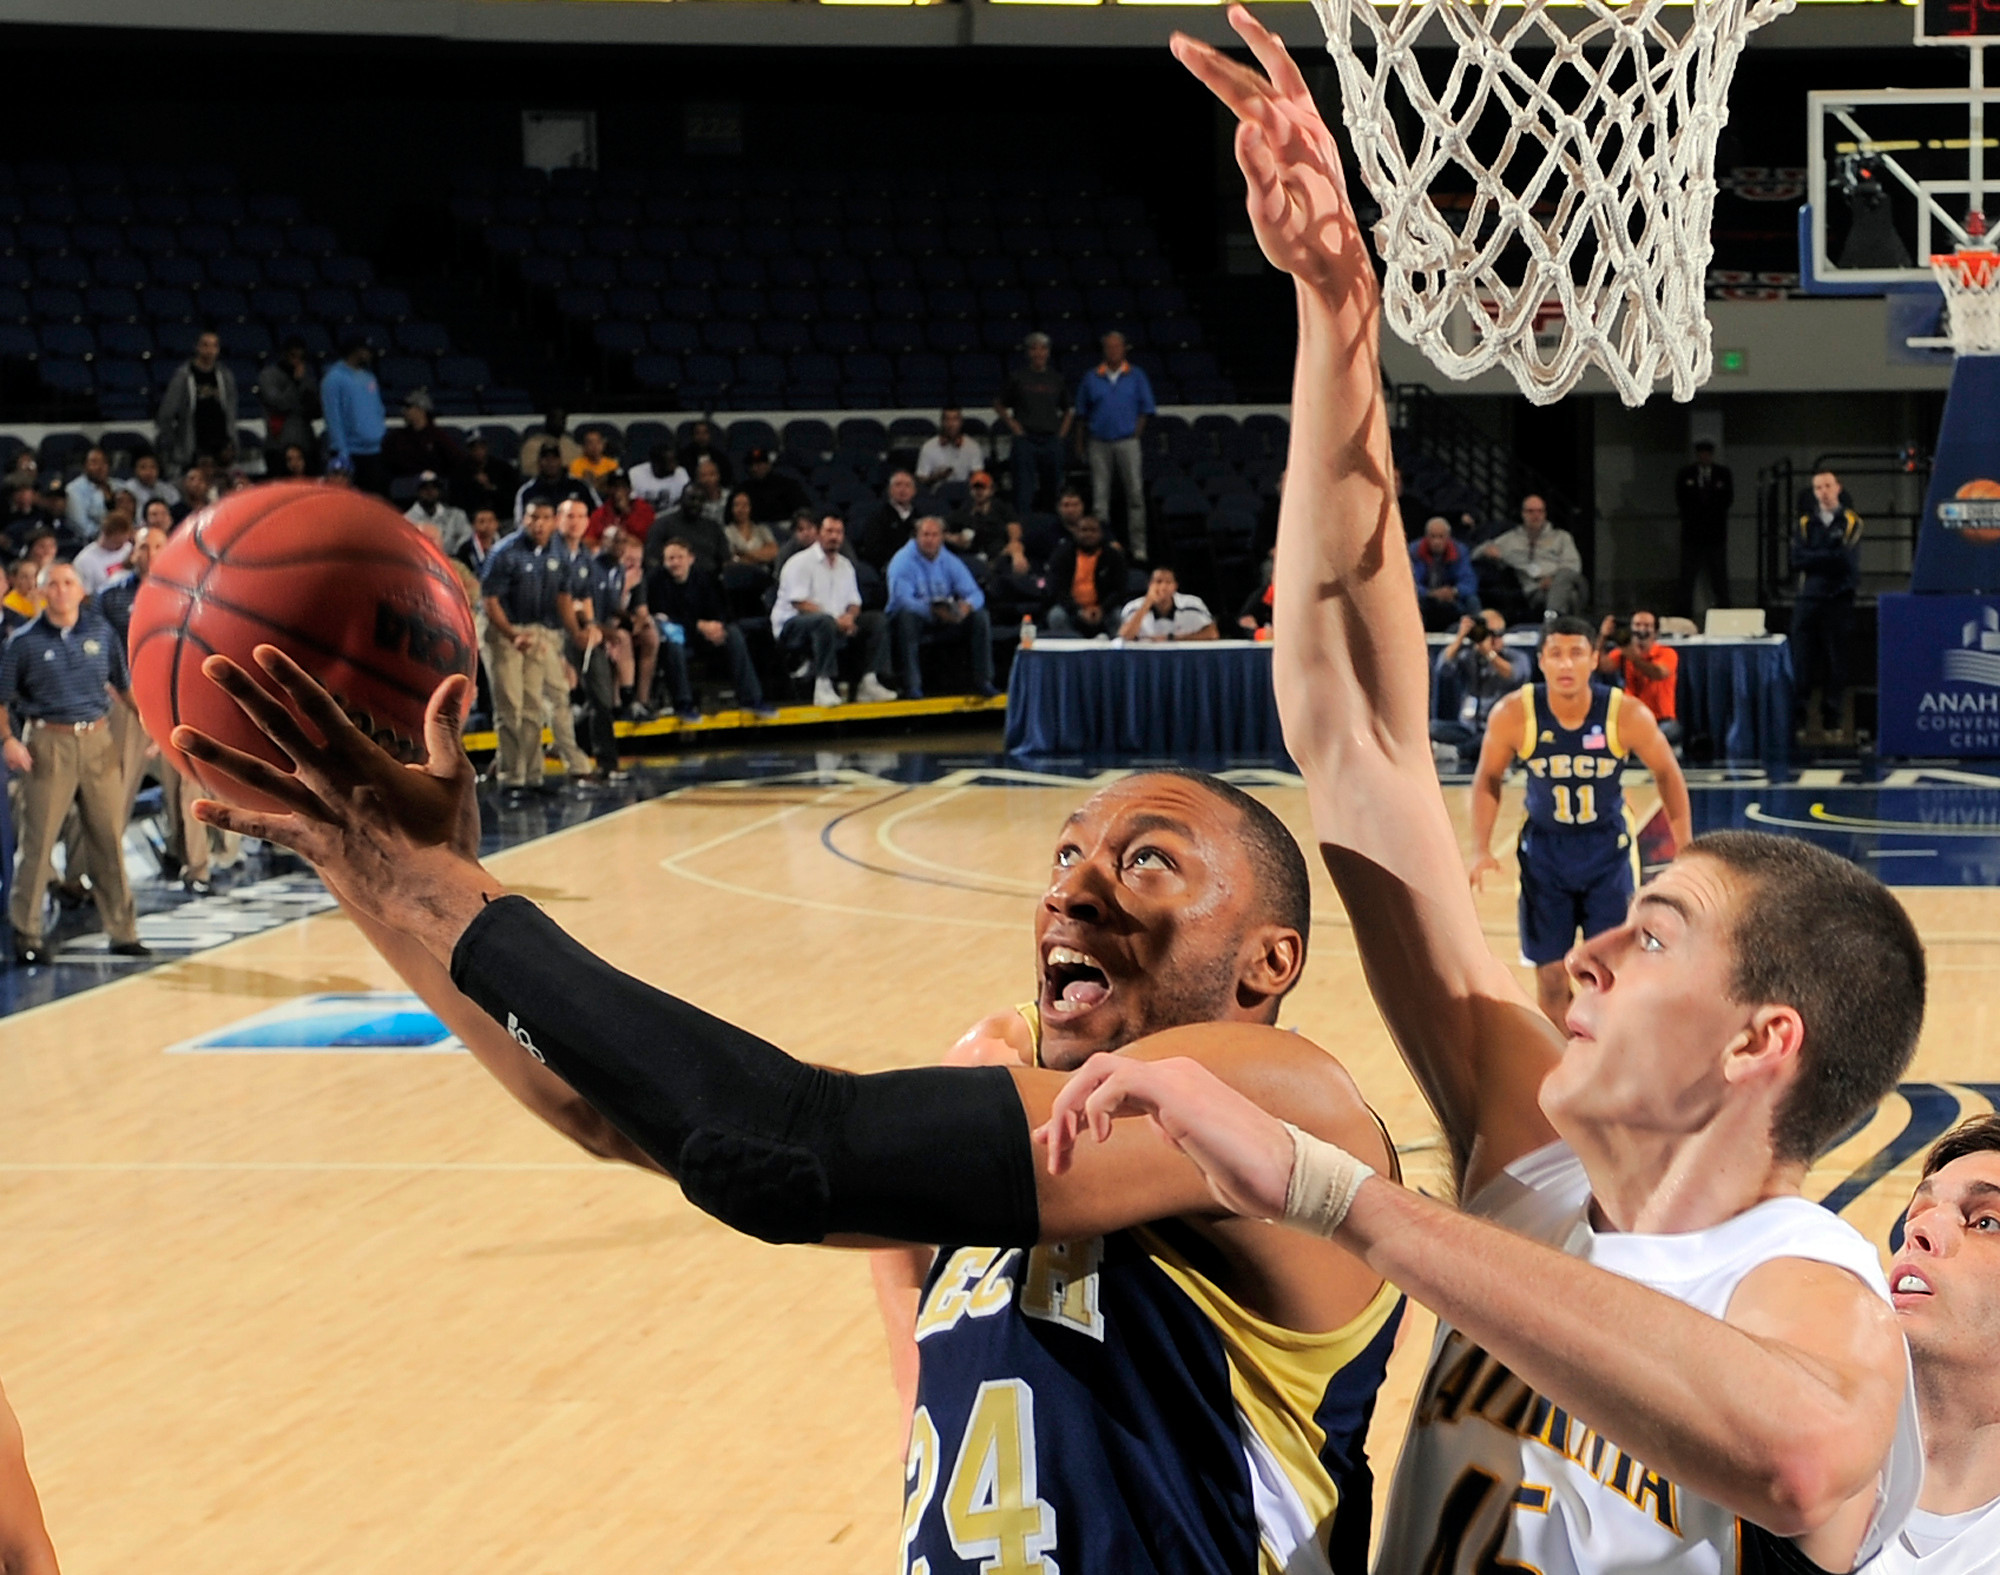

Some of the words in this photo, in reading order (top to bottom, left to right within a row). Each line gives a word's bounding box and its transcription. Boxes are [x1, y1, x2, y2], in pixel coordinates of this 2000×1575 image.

[1918, 692, 1998, 713] ANAH
[1552, 785, 1598, 824] 11
[892, 1376, 1060, 1575] 24
